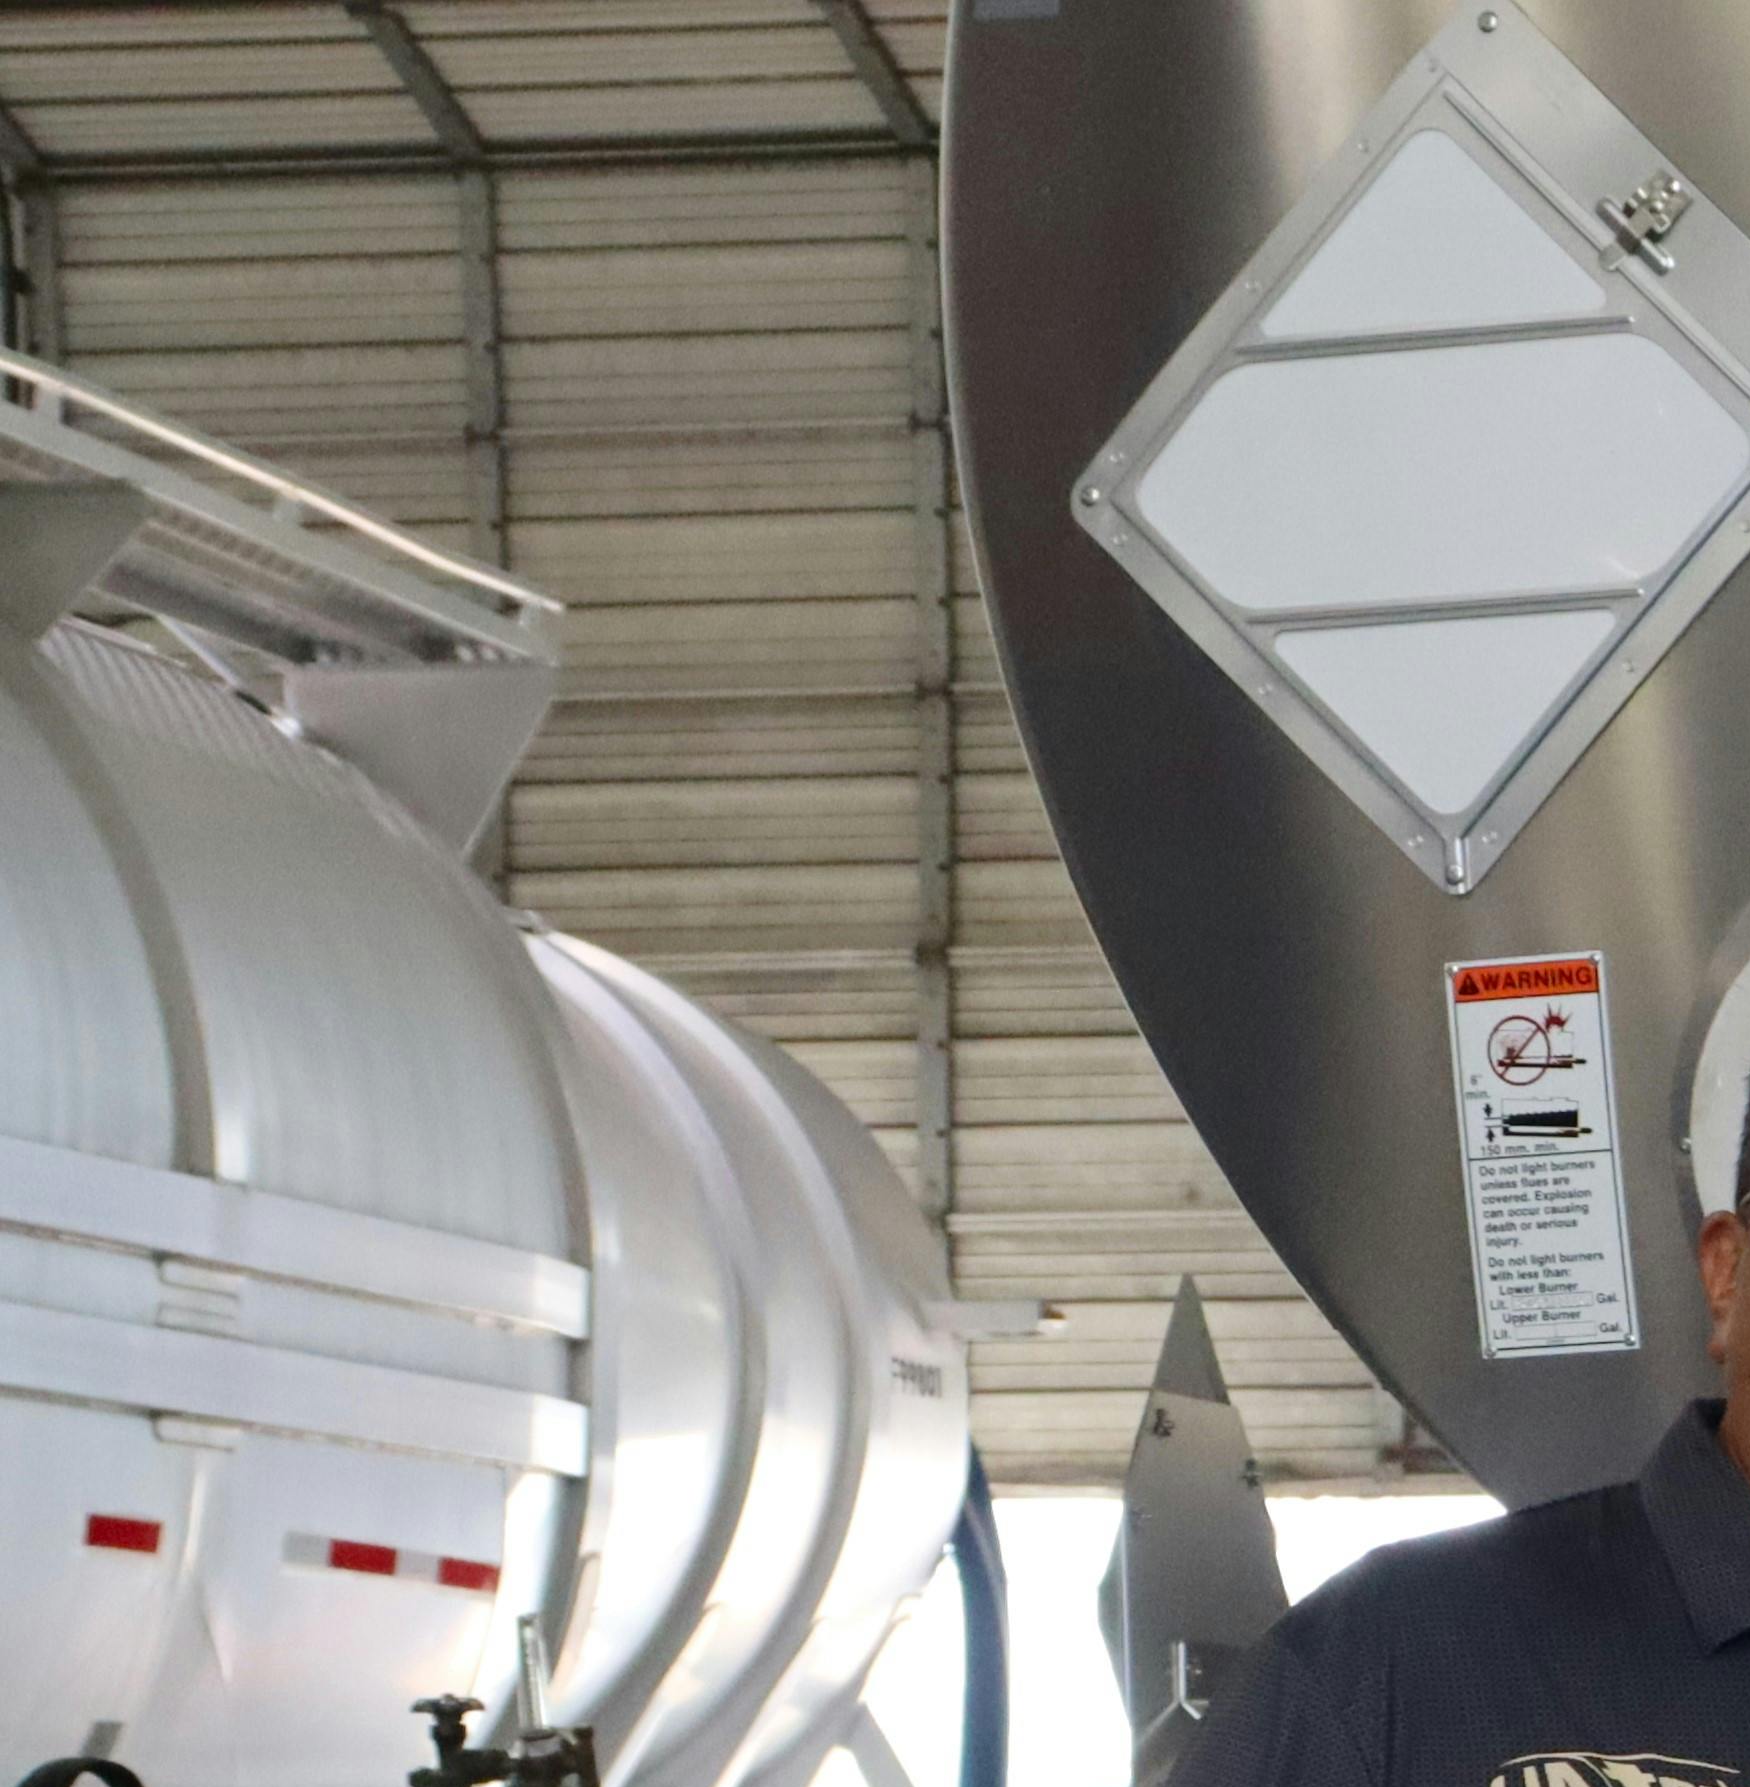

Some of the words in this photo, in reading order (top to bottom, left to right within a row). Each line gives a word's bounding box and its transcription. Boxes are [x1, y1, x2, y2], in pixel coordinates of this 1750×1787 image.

[1480, 966, 1593, 991] WARNING
[1481, 1145, 1501, 1157] 150
[1479, 1165, 1496, 1176] Do
[1500, 1164, 1519, 1175] not
[1521, 1162, 1548, 1176] light
[1551, 1160, 1596, 1172] burners
[1480, 1179, 1517, 1190] unless
[1521, 1177, 1549, 1187] flues
[1552, 1176, 1570, 1186] are
[1482, 1193, 1531, 1205] covered.
[1535, 1189, 1592, 1203] Explosion
[1483, 1209, 1504, 1219] can
[1507, 1206, 1541, 1217] occur
[1544, 1202, 1590, 1216] causing
[1485, 1220, 1518, 1233] death
[1520, 1220, 1533, 1230] or
[1536, 1217, 1578, 1230] serious
[1486, 1236, 1522, 1249] injury.
[1488, 1256, 1505, 1267] Do
[1508, 1255, 1528, 1267] not
[1530, 1253, 1557, 1267] light
[1559, 1251, 1605, 1263] burners
[1490, 1270, 1514, 1282] with
[1517, 1269, 1539, 1280] less
[1543, 1267, 1571, 1279] than:
[1499, 1284, 1535, 1296] Lower
[1538, 1281, 1579, 1293] Burner
[1502, 1312, 1538, 1326] Upper
[1542, 1310, 1582, 1321] Burner
